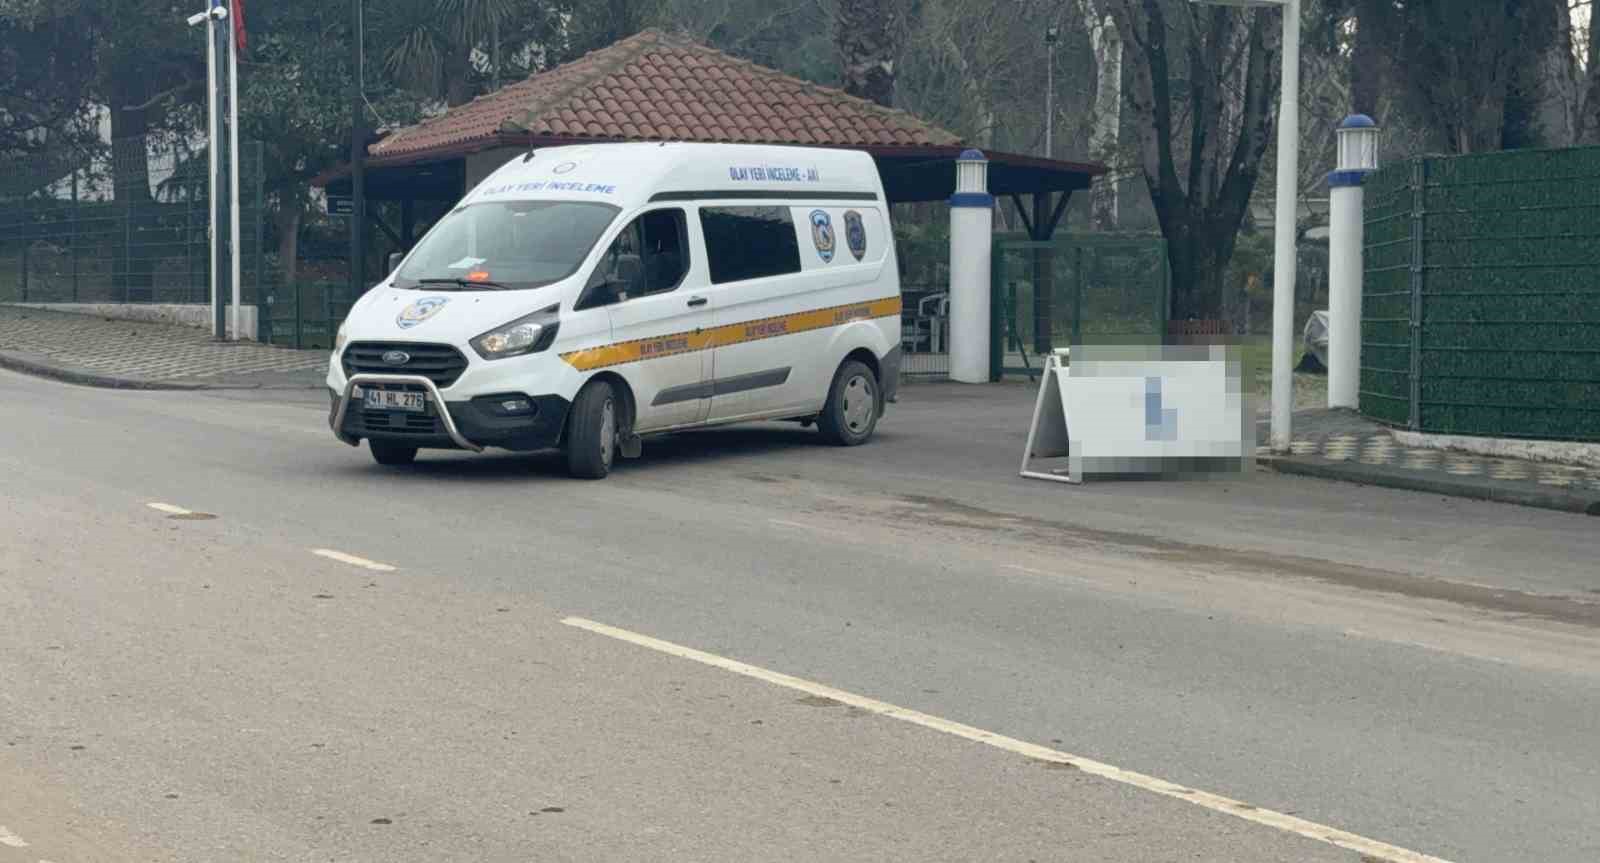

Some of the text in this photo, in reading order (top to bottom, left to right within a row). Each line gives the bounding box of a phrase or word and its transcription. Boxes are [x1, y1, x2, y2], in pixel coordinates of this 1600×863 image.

[730, 167, 747, 181] OLAY
[370, 391, 423, 407] 41 HL 276
